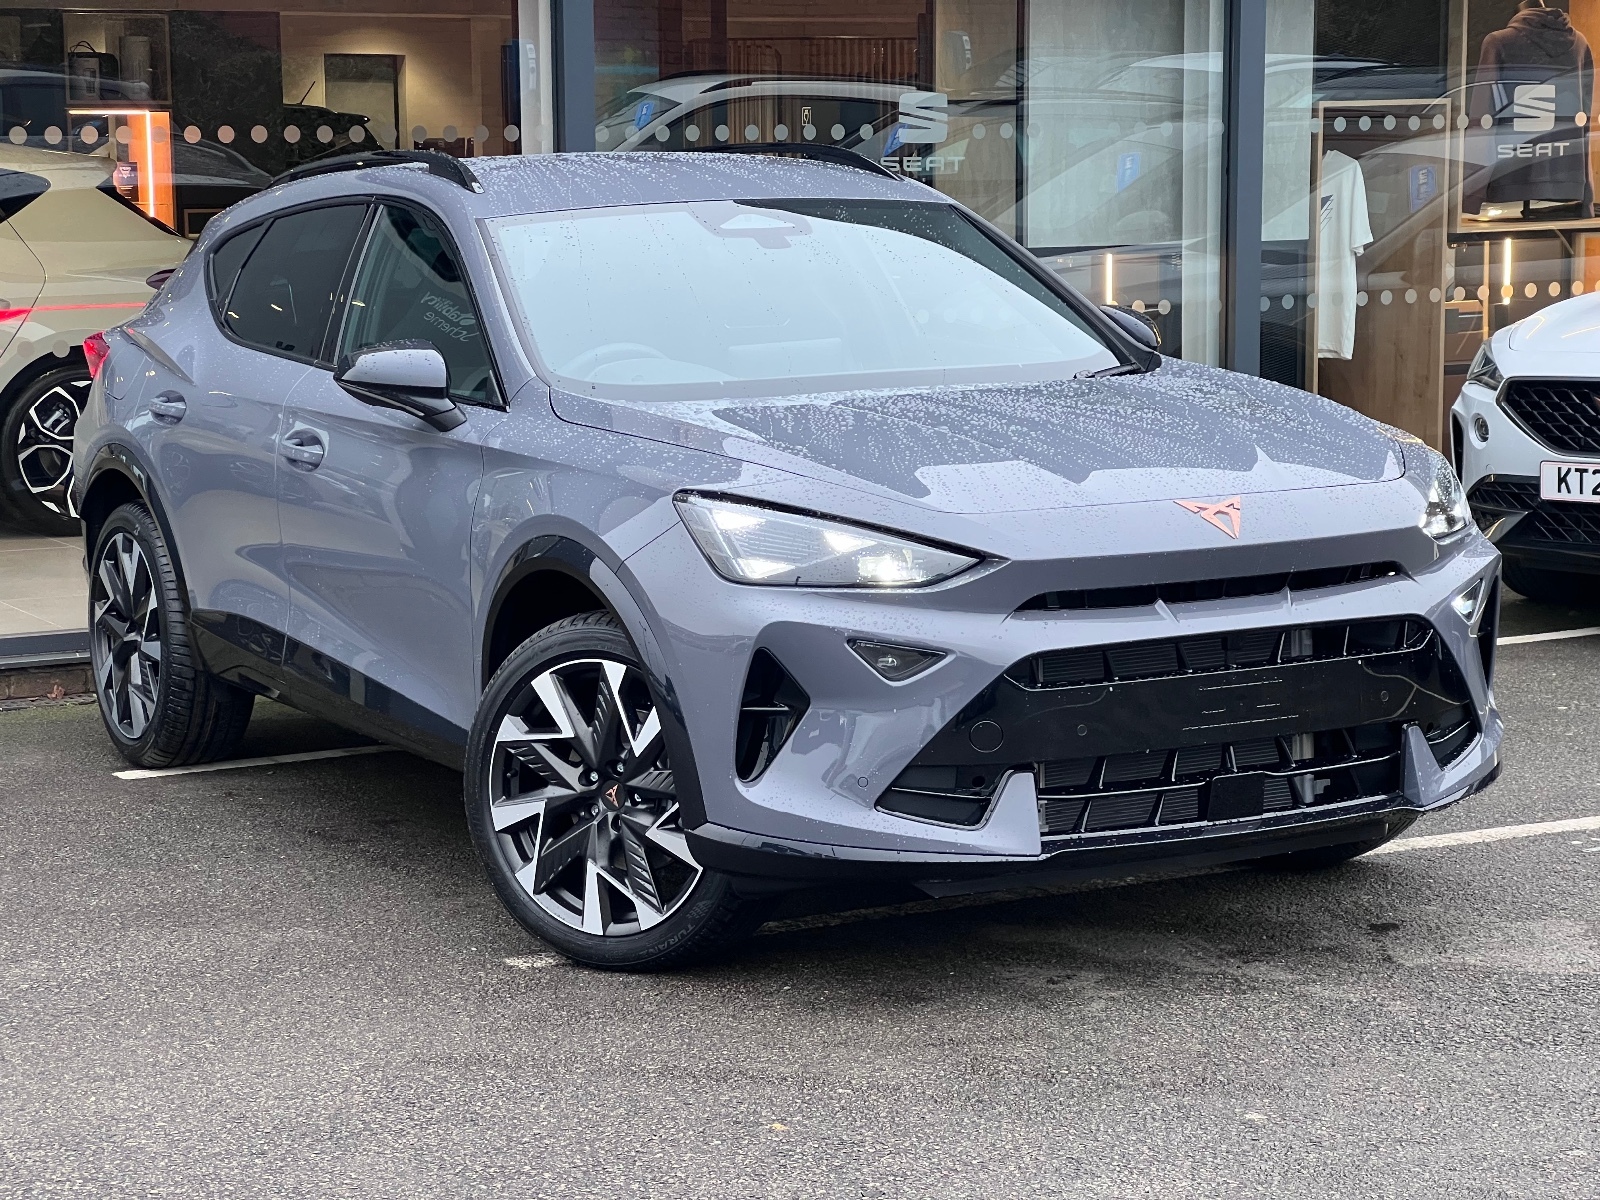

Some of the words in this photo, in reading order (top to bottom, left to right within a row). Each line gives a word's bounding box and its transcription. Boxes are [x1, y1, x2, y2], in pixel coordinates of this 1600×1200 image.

[1497, 142, 1570, 159] SEAT
[880, 156, 966, 172] SEAT
[1557, 466, 1600, 496] KT2
